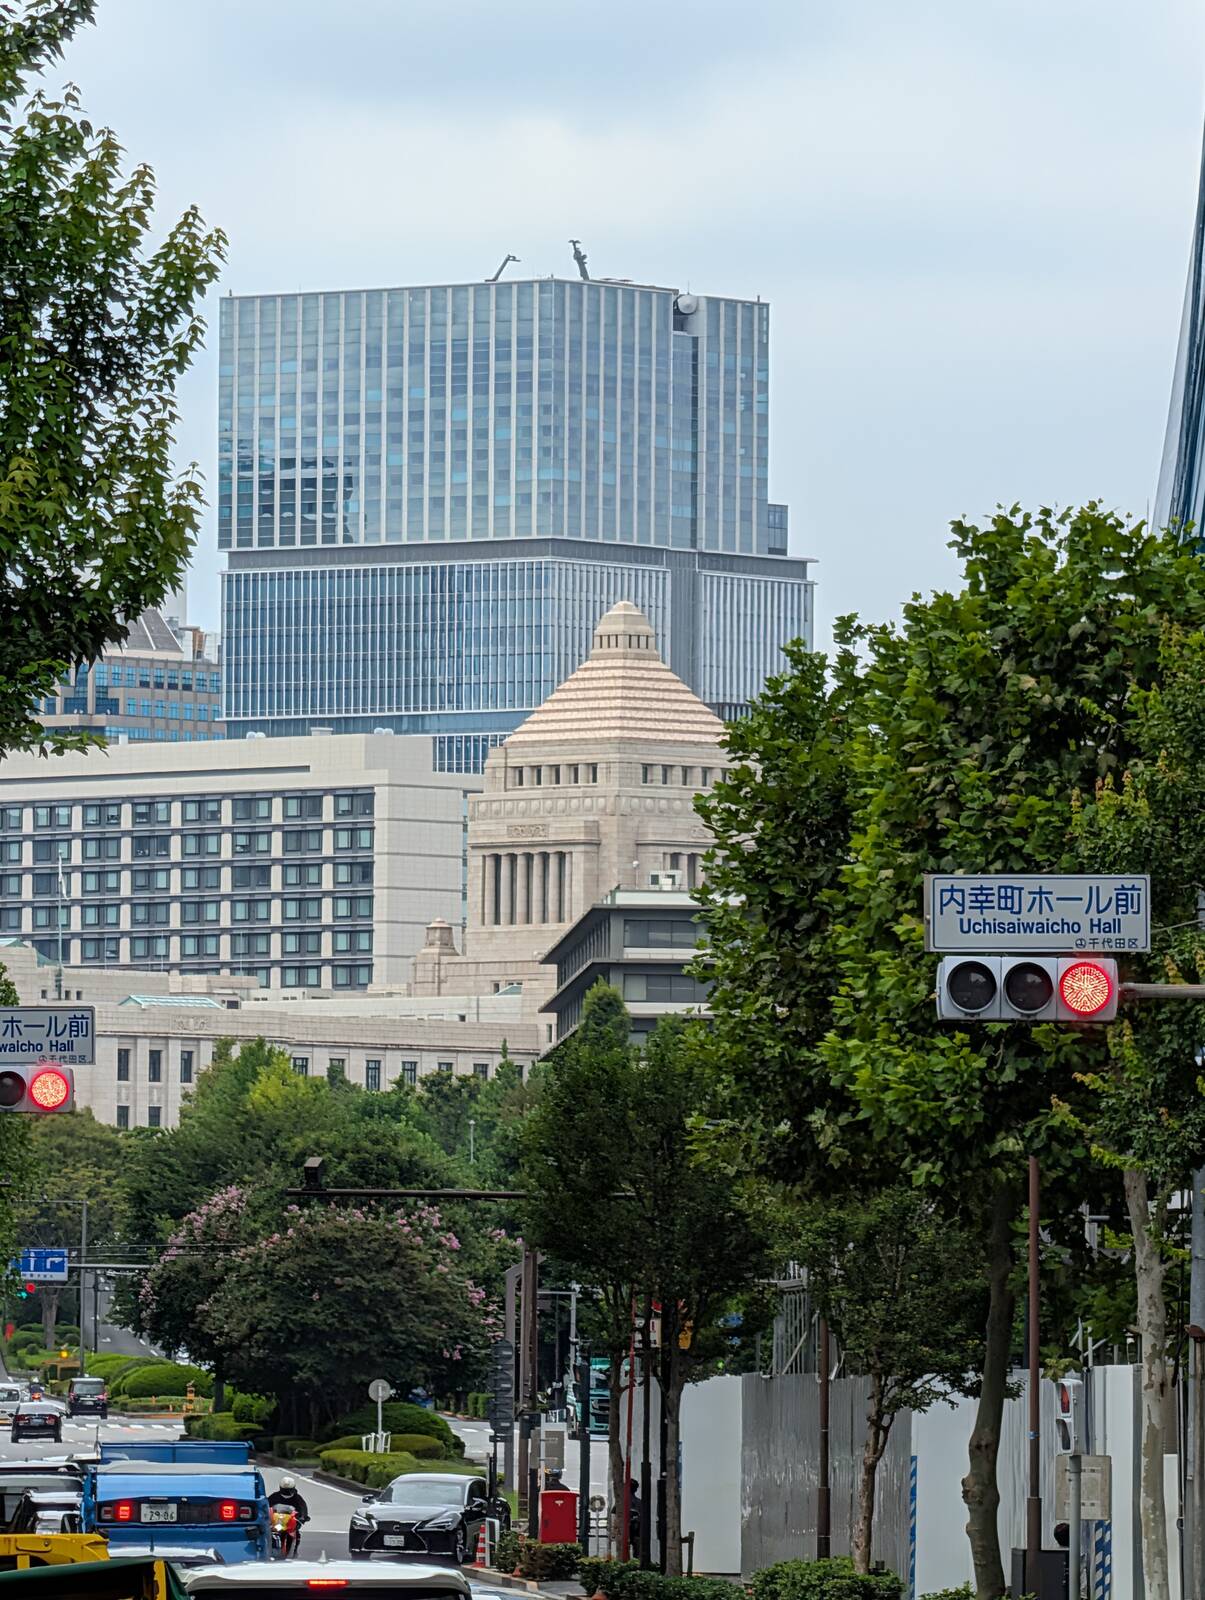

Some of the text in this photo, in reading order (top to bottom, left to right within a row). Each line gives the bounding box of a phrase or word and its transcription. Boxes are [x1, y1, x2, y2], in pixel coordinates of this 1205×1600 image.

[939, 884, 1142, 915] 内幸町ホール前
[959, 918, 1121, 934] Uchisaiwaicho Hall
[2, 1014, 90, 1038] ホール前
[50, 1040, 74, 1052] Hall
